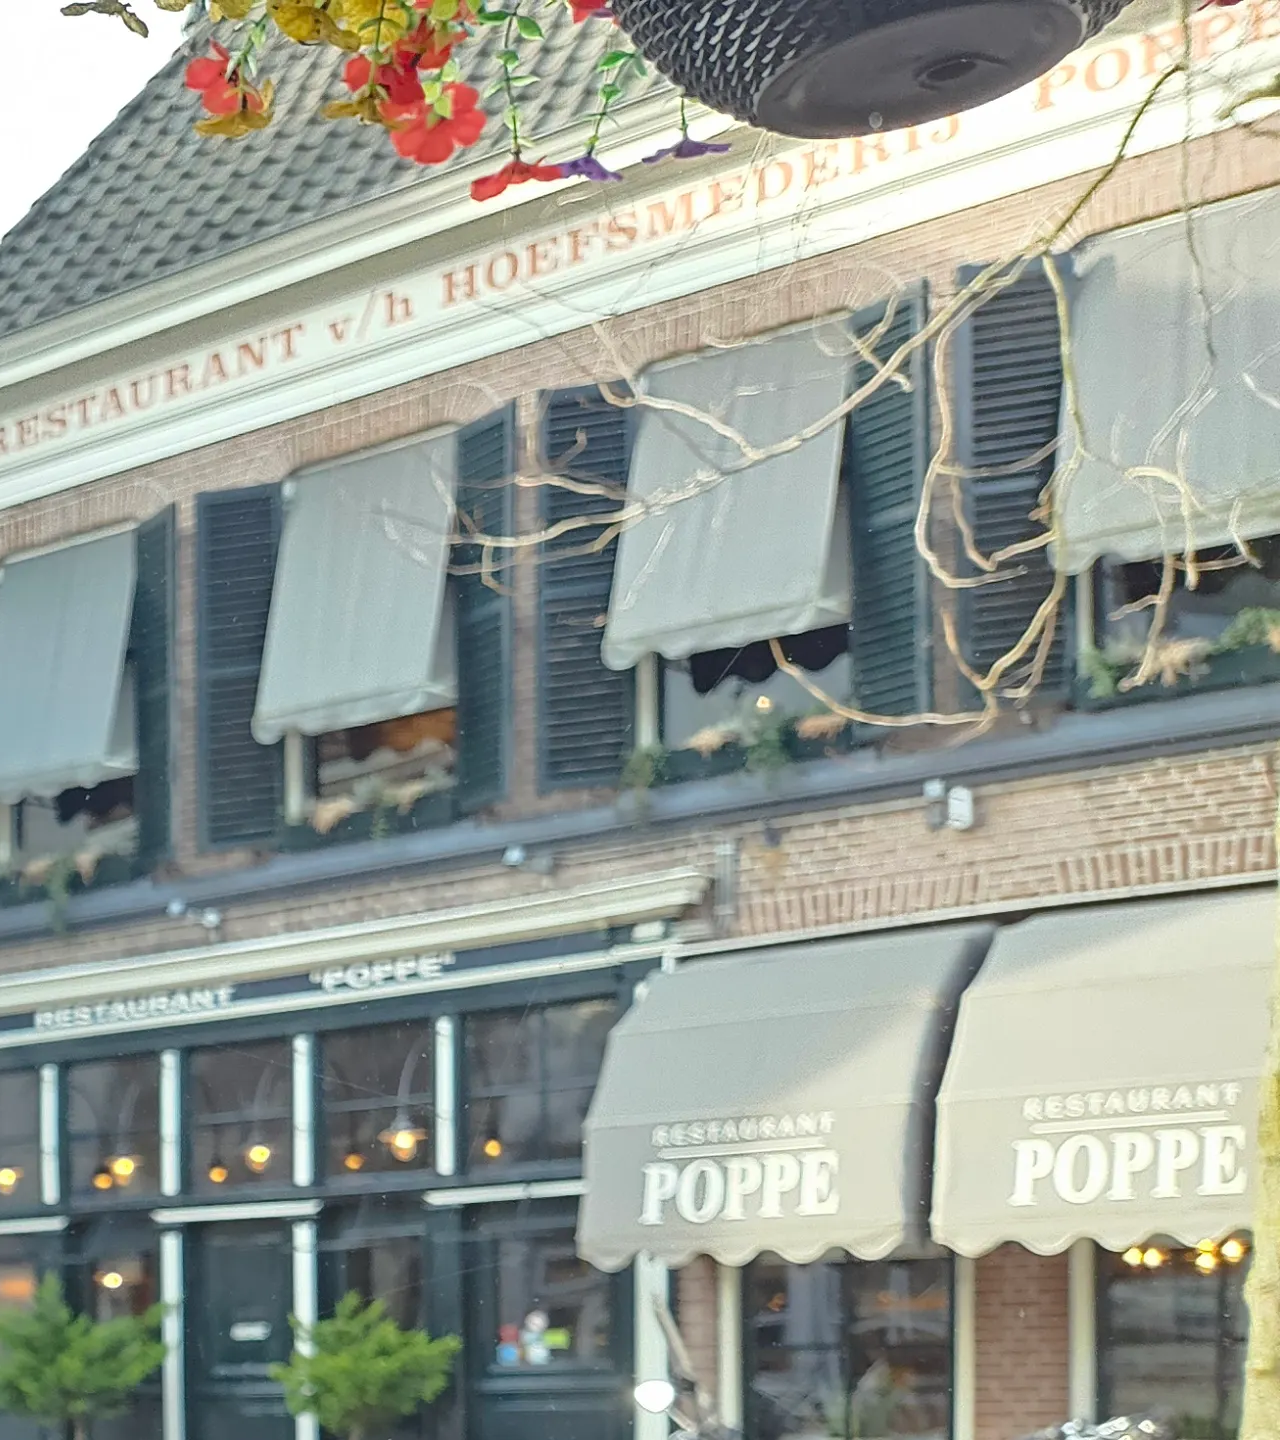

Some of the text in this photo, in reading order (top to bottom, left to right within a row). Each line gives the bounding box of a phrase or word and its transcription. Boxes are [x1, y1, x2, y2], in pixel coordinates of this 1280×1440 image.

[329, 289, 414, 341] v/h
[35, 984, 235, 1030] RESTAURANT
[1023, 1082, 1241, 1121] RESTAURANT
[651, 1110, 835, 1147] RESTAURANT
[637, 1150, 839, 1226] POPPE
[1007, 1125, 1247, 1207] POPPE
